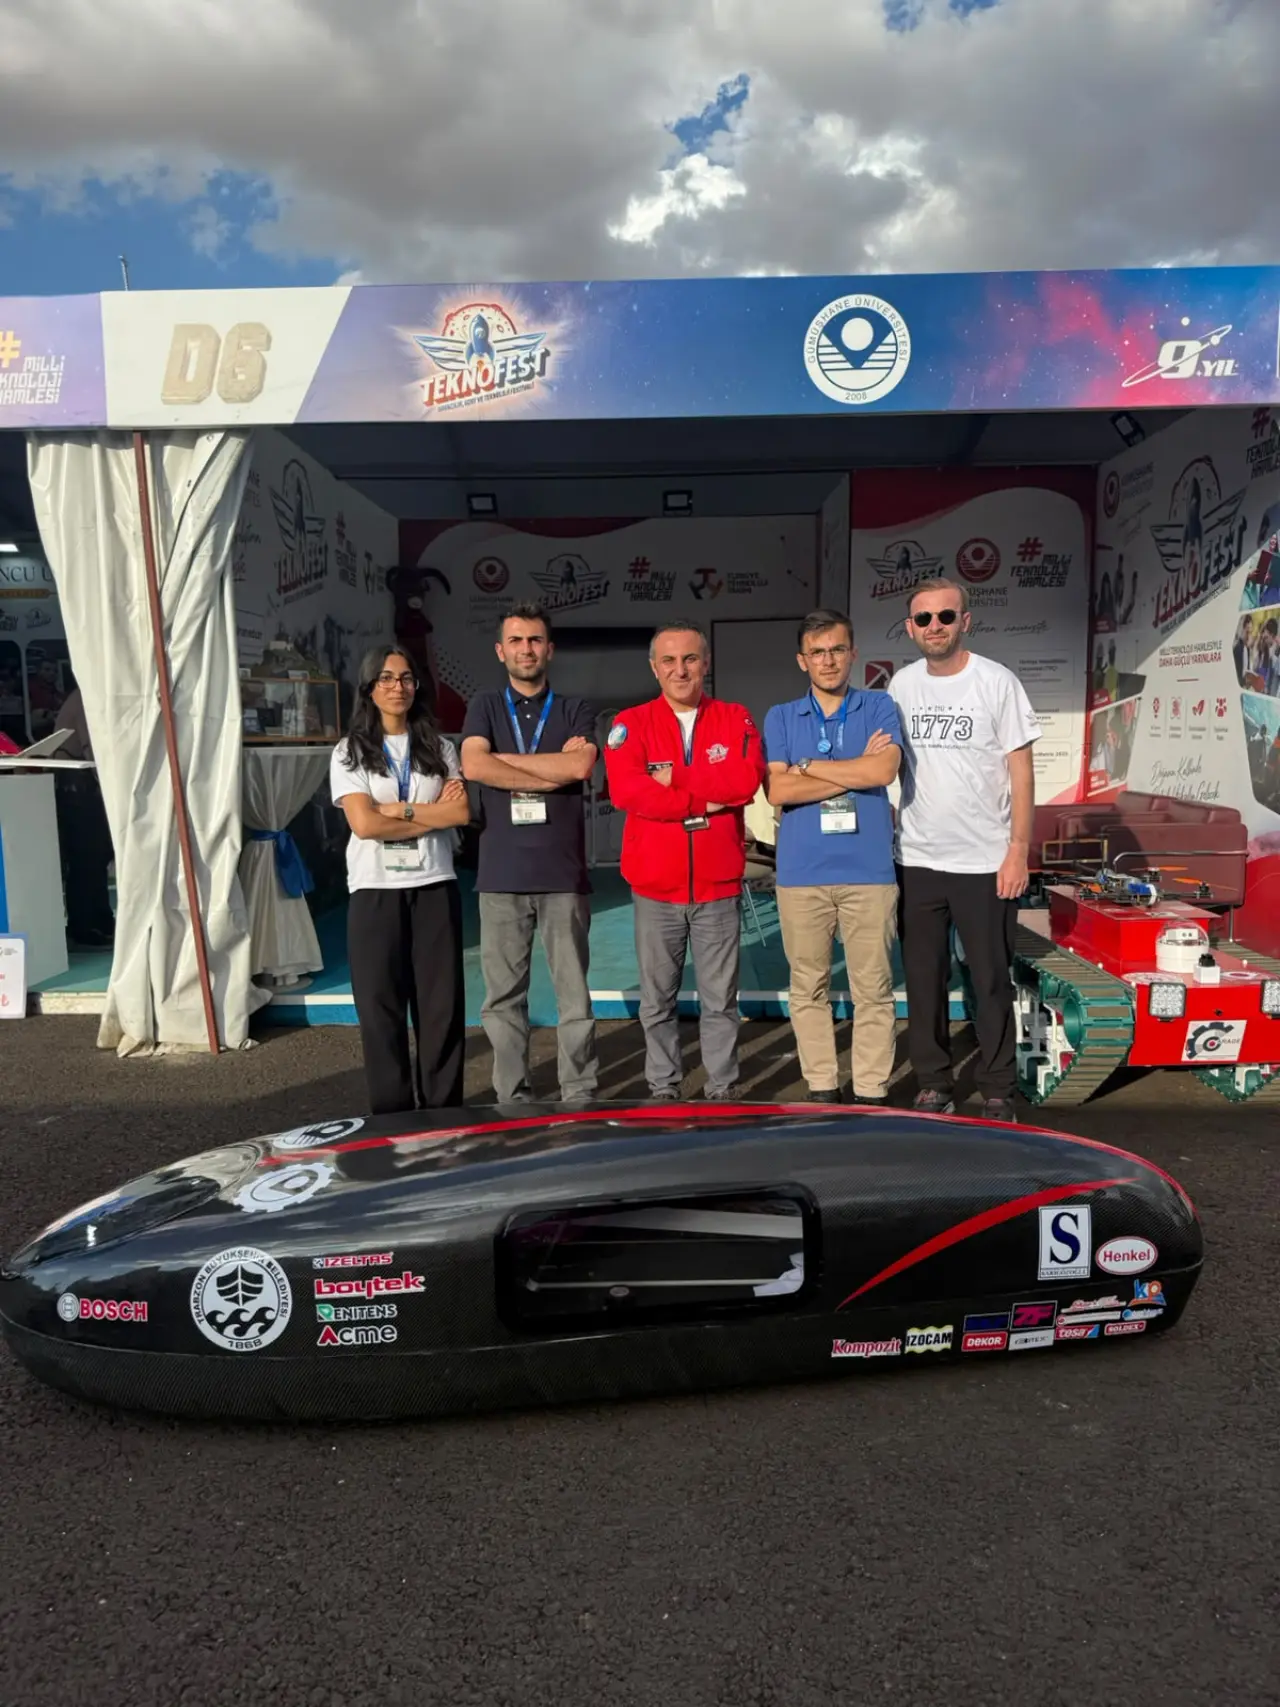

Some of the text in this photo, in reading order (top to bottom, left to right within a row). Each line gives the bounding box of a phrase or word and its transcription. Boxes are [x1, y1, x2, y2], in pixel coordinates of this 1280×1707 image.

[807, 299, 852, 364] GÜMÜŞHANE
[162, 322, 272, 405] D6
[421, 348, 550, 406] TEKNOFEST
[845, 392, 868, 401] 2008
[911, 714, 974, 742] 1773
[1050, 1211, 1081, 1265] S
[1103, 1248, 1151, 1263] Henkel
[193, 1274, 206, 1324] TRABZON
[266, 1261, 290, 1319] BELEDİYESİ
[314, 1271, 425, 1299] boytek
[80, 1298, 148, 1322] BOSCH
[317, 1325, 398, 1346] Acme
[833, 1338, 901, 1357] Kompozit
